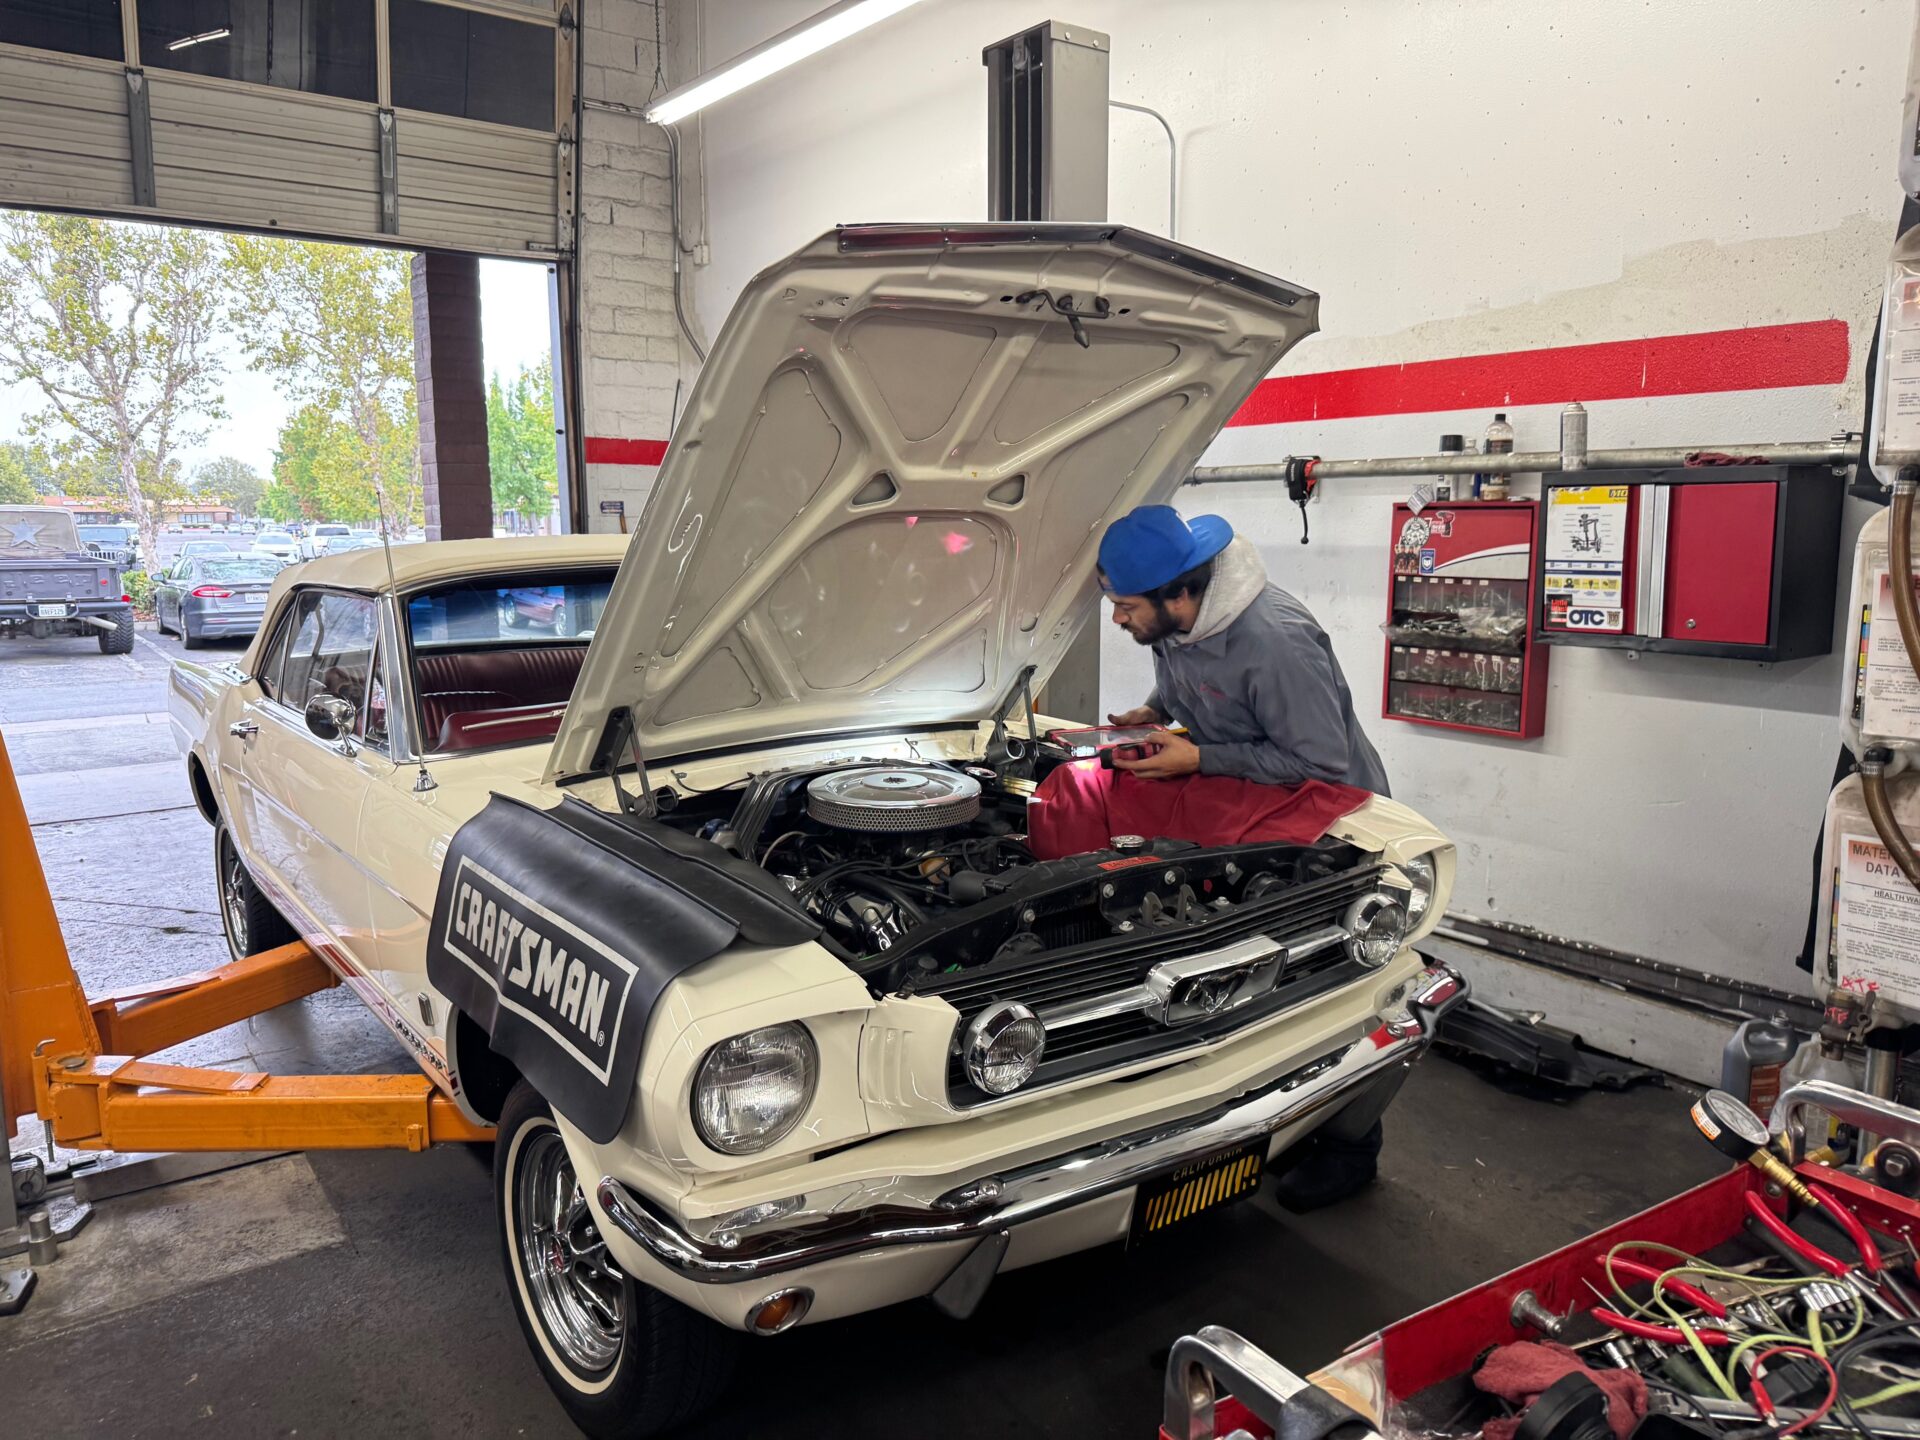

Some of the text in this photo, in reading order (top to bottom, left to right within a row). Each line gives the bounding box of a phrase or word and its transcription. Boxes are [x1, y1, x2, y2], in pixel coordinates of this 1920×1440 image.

[1569, 609, 1605, 626] OTC
[1866, 861, 1900, 878] DATA
[1874, 890, 1905, 902] HEALTH
